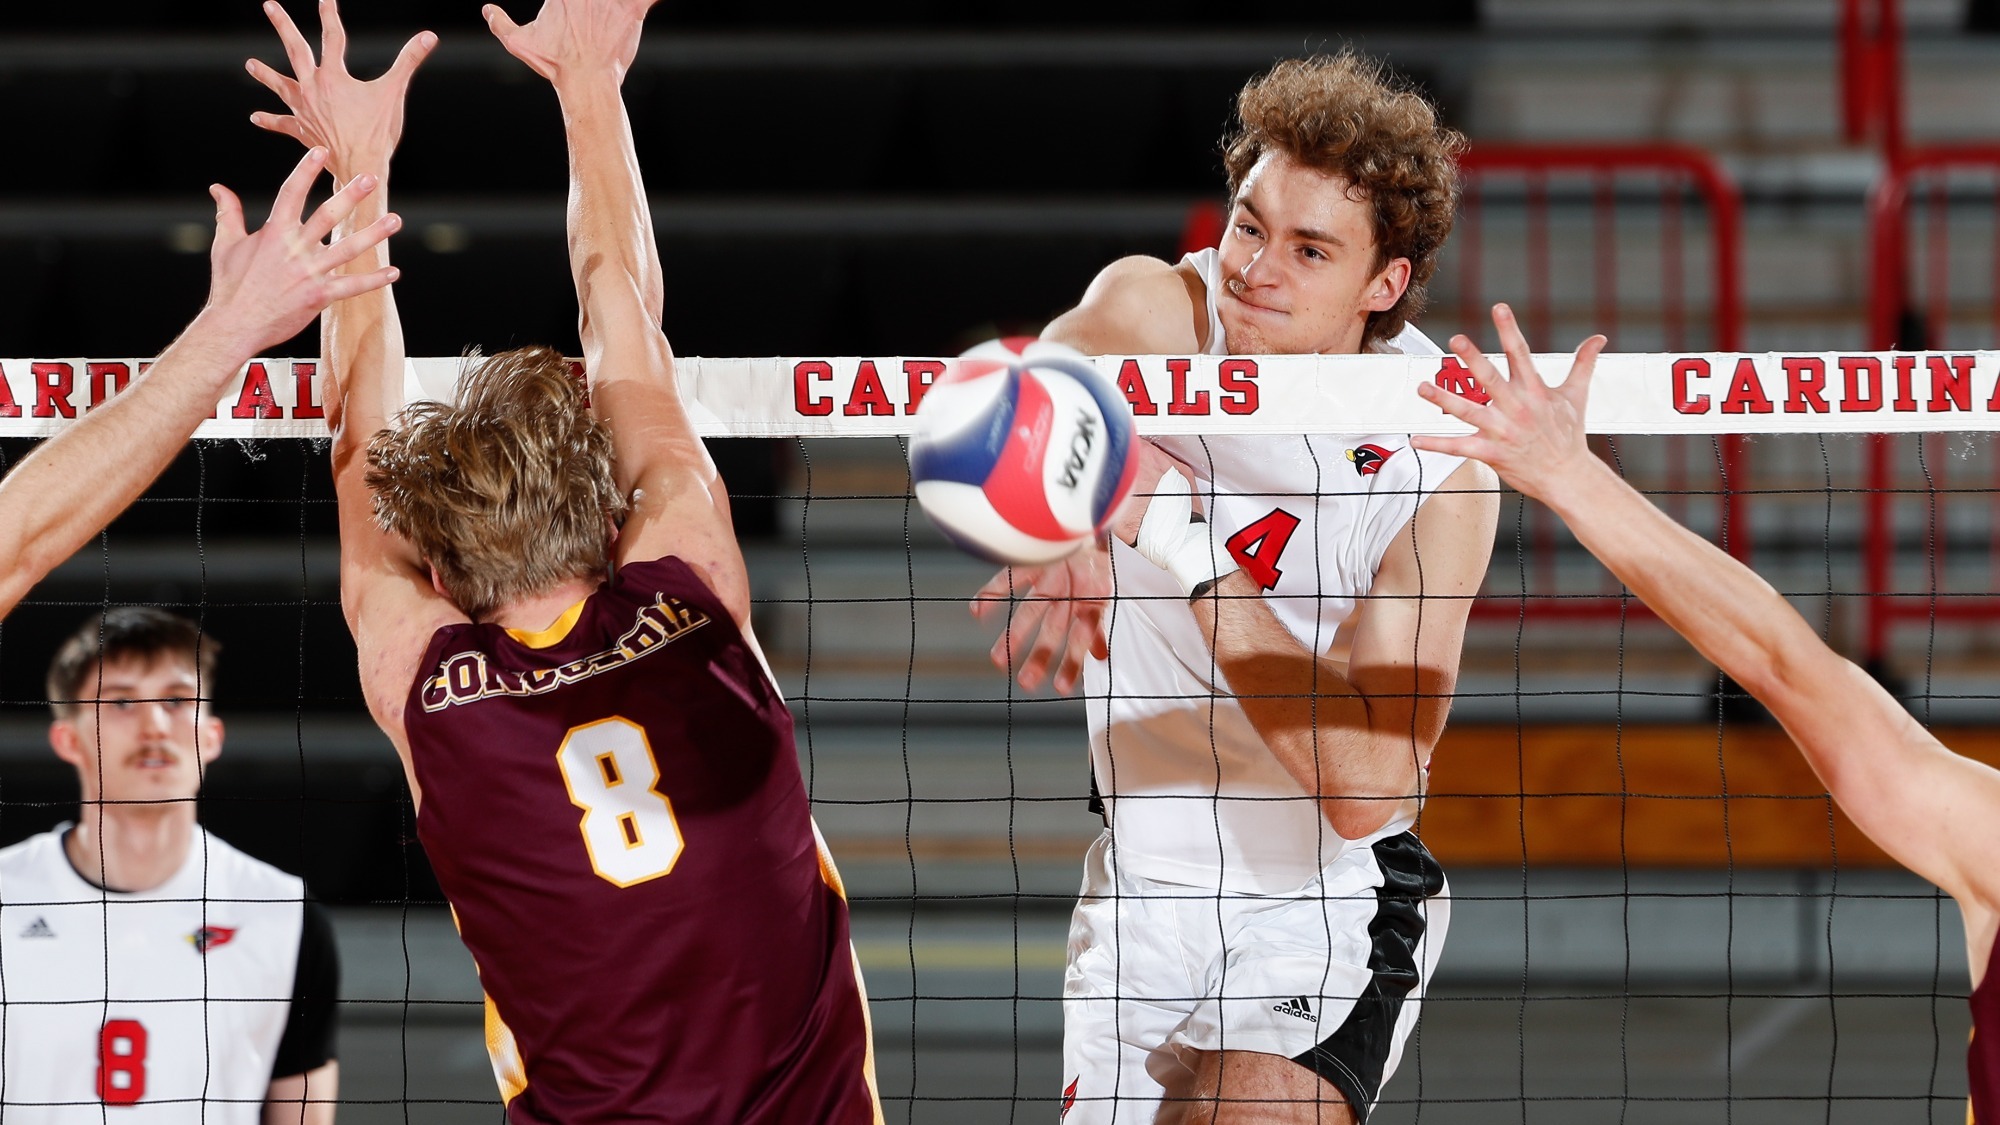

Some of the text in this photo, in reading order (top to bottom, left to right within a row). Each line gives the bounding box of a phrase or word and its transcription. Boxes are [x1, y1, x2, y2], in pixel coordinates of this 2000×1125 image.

[793, 359, 1260, 417] CARALS
[1671, 355, 2000, 415] CARDIN
[1056, 407, 1096, 491] NCAA
[1224, 506, 1301, 594] 4
[421, 591, 711, 713] CONCDIA
[555, 714, 685, 889] 8
[1272, 1003, 1318, 1023] adidas
[95, 1019, 148, 1107] 8
